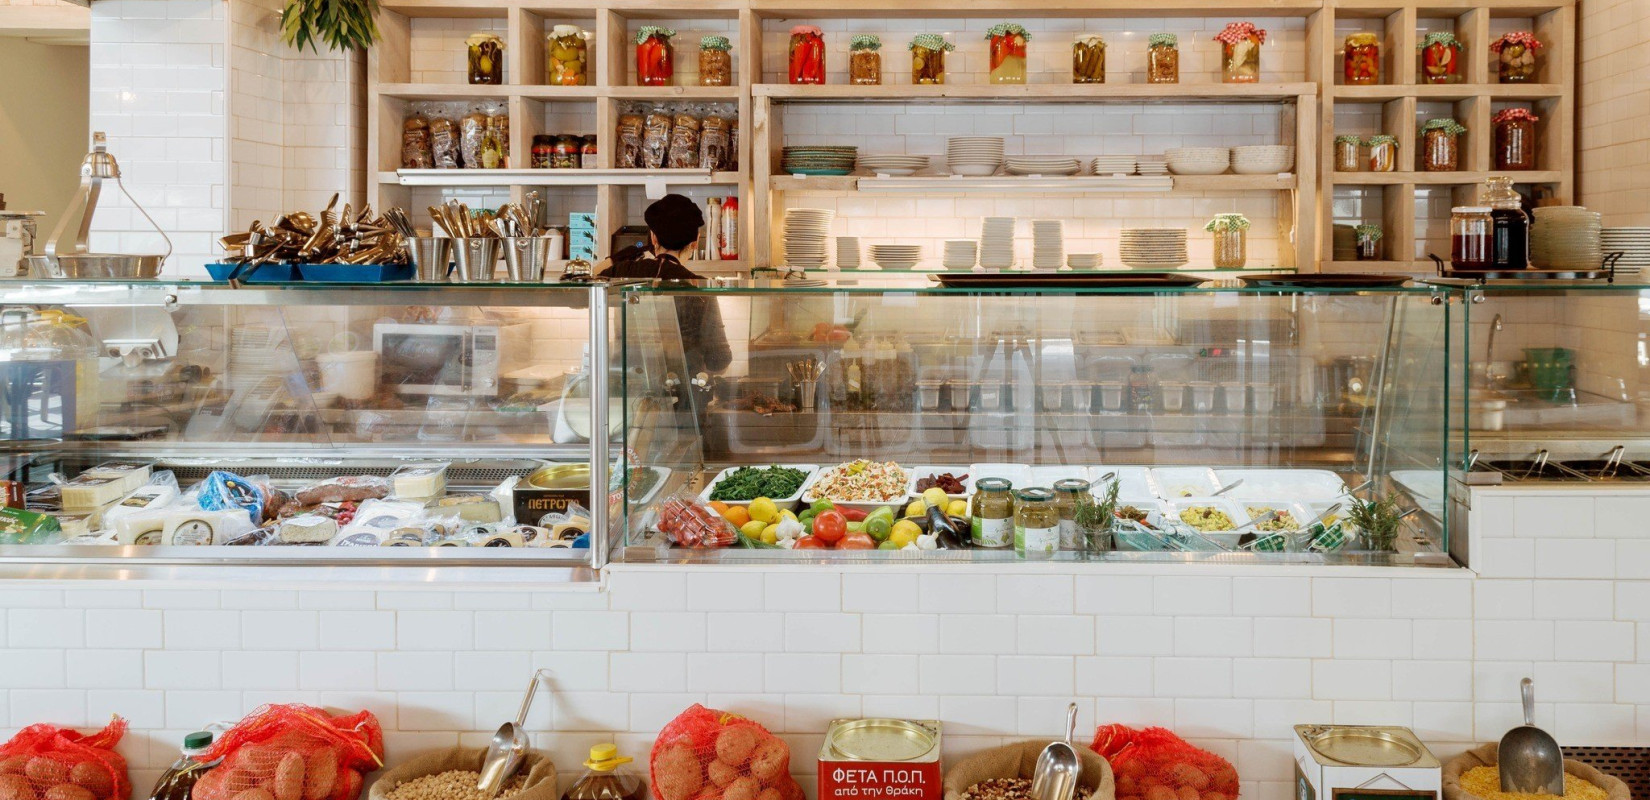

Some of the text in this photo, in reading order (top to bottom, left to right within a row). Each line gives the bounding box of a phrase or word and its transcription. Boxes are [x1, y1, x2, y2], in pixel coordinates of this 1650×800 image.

[832, 767, 926, 783] ΦΕΤΑ Π.Ο.Π.
[834, 785, 859, 796] από
[861, 787, 883, 797] την
